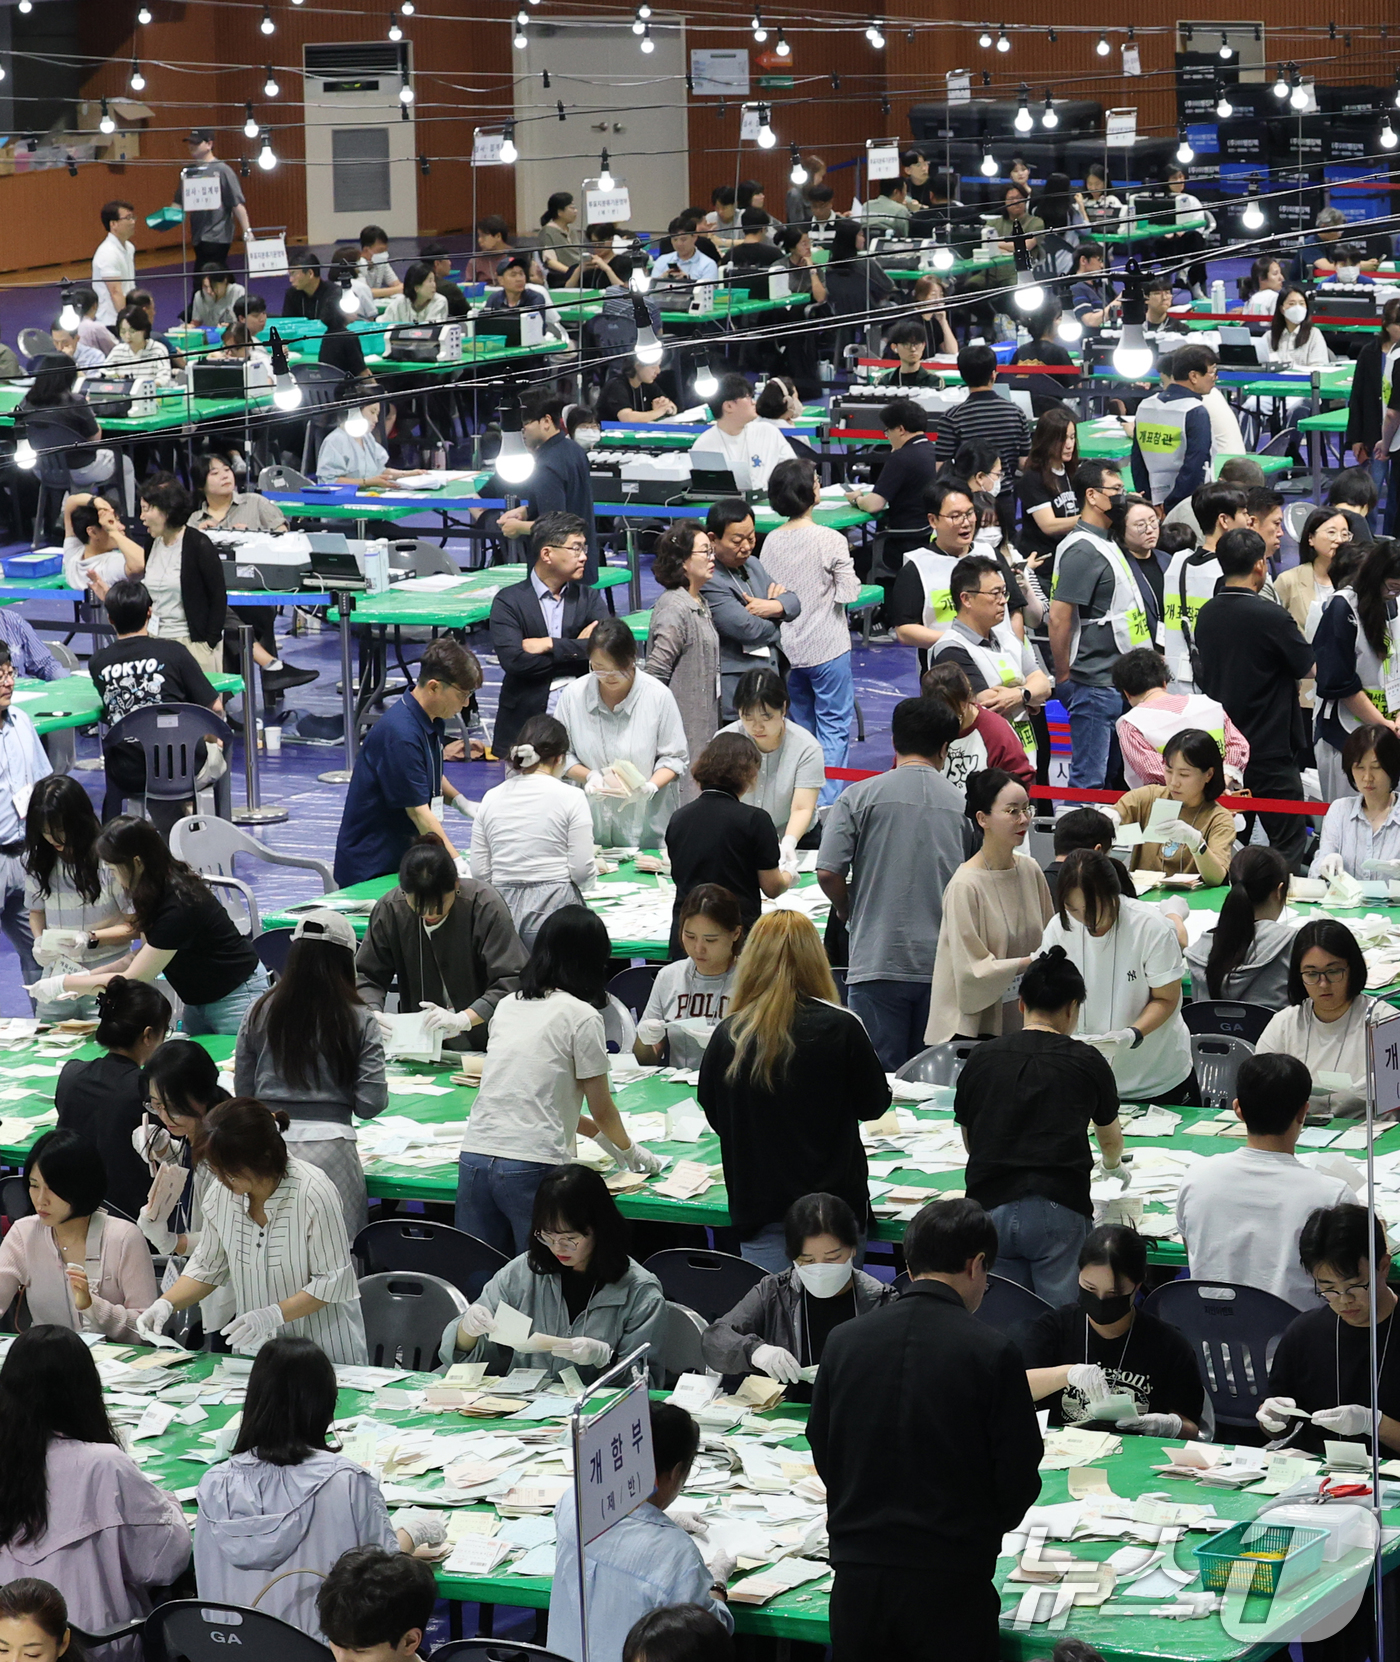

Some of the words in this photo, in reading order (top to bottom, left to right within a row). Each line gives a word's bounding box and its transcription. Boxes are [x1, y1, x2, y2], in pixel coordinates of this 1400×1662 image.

[1139, 430, 1174, 446] 개표참관
[101, 658, 158, 682] TOKYO
[1220, 1022, 1243, 1031] GA
[1385, 1042, 1399, 1070] 개
[210, 1631, 243, 1645] GA
